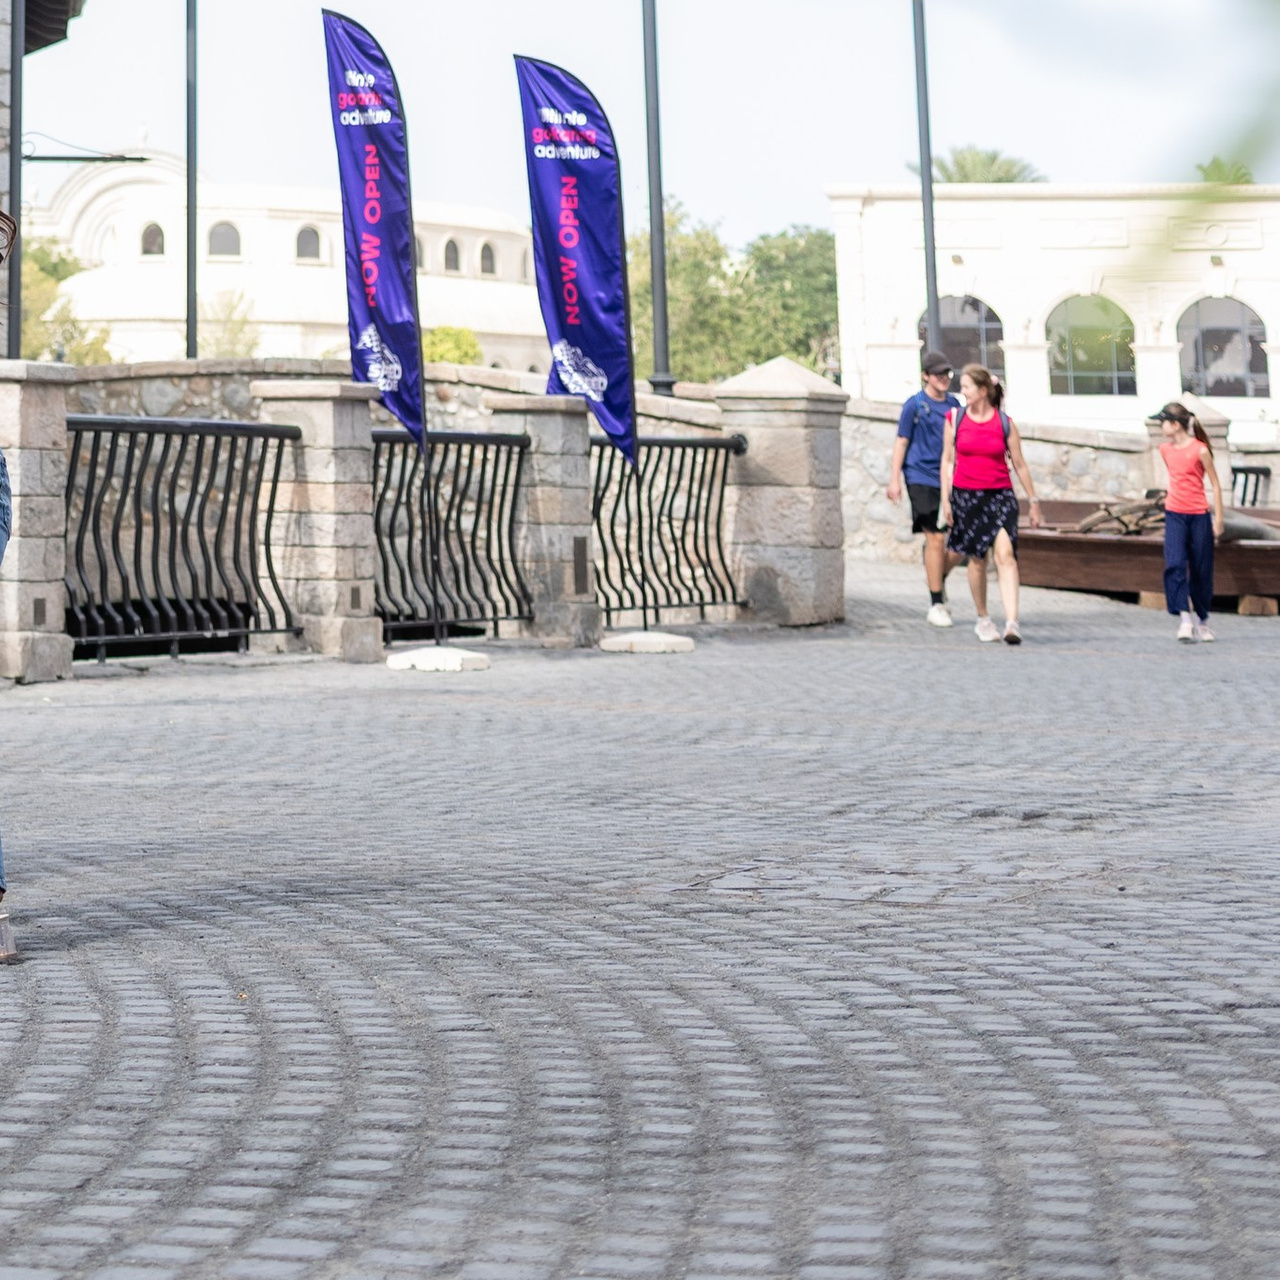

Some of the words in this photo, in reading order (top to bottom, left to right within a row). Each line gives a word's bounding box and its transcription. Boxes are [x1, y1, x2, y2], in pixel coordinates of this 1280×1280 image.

[363, 144, 382, 224] OPEN
[559, 176, 579, 249] OPEN
[360, 231, 381, 308] NOW
[560, 255, 580, 325] NOW
